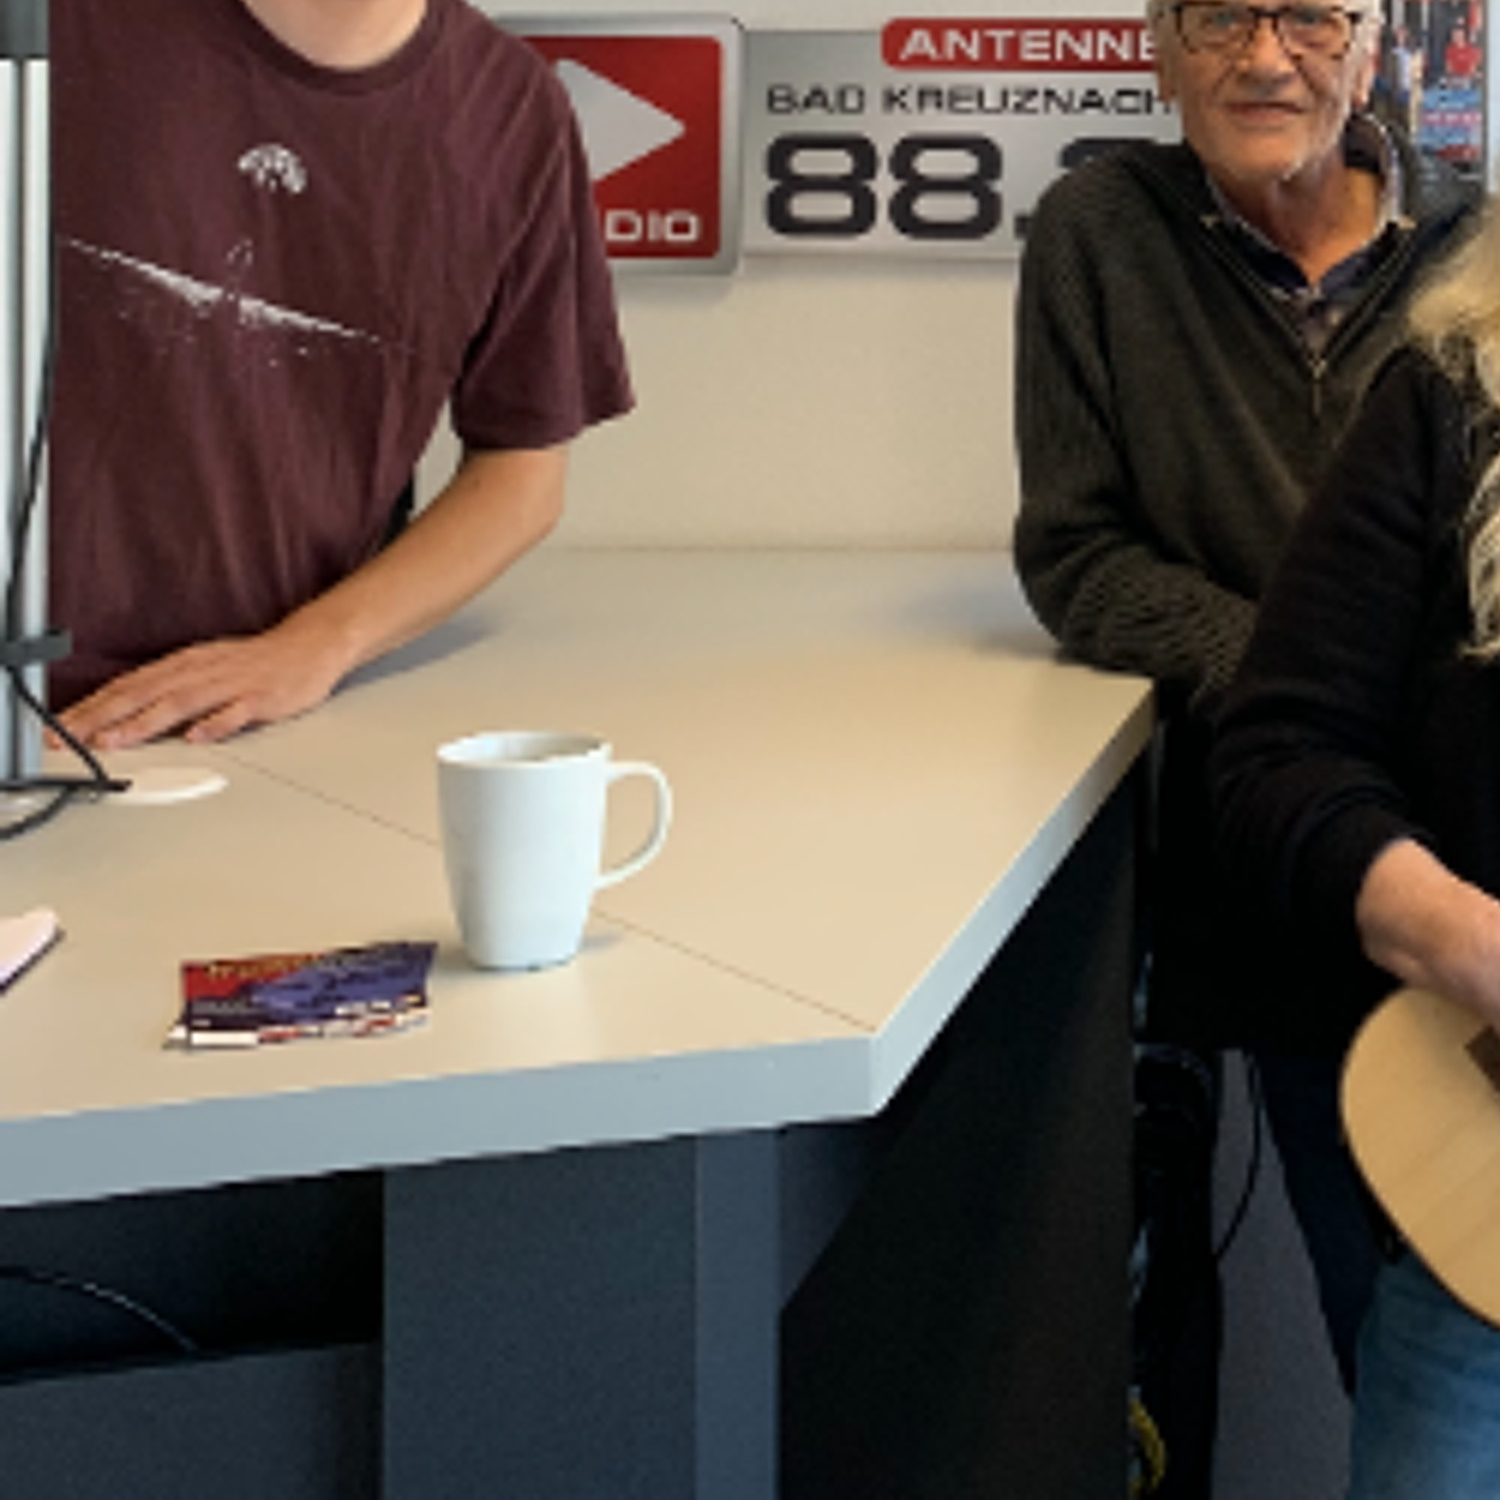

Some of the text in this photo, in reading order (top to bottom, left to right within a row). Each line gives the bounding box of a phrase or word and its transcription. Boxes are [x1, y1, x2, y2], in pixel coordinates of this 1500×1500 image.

[899, 28, 1157, 62] ANTENNE
[765, 86, 1172, 116] BAD KREUZNACH
[604, 208, 702, 243] DIO
